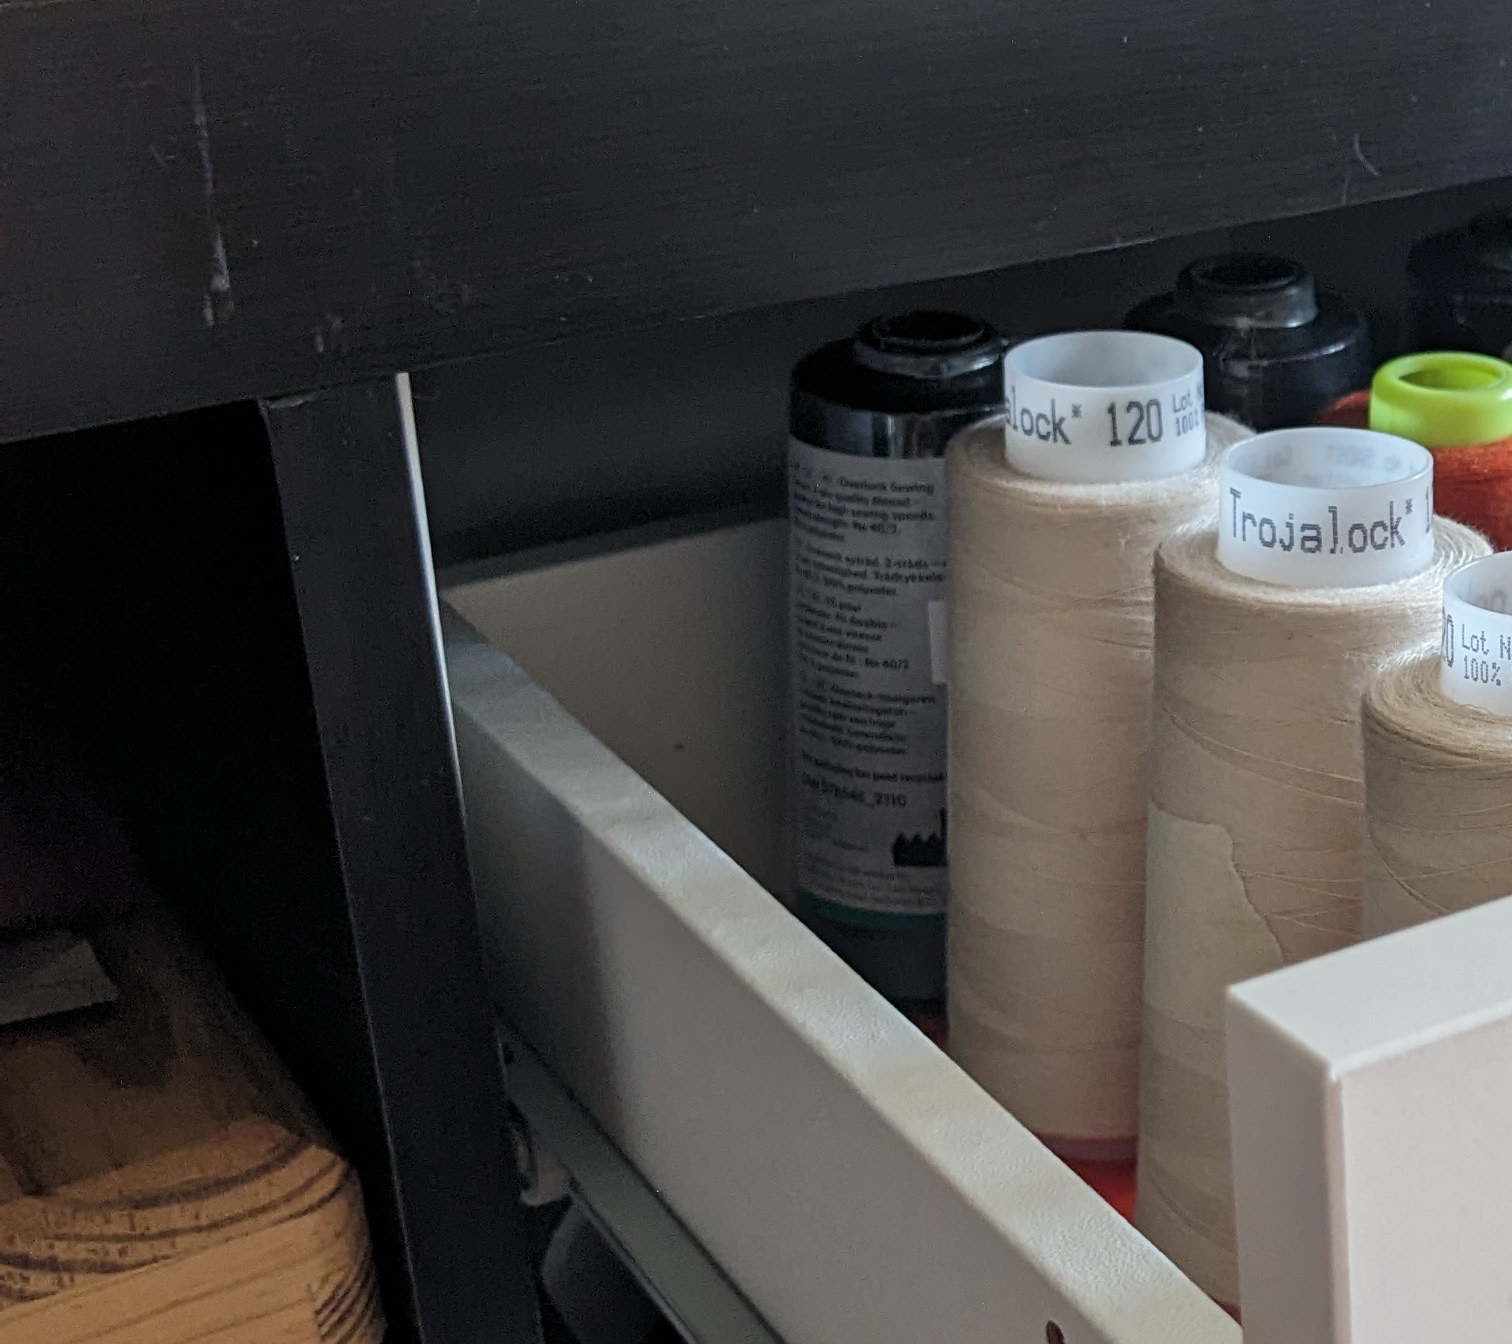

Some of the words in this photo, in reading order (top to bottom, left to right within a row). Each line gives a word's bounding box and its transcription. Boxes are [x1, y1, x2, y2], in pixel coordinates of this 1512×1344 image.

[1171, 388, 1194, 413] Lot
[1107, 398, 1163, 447] 120
[1461, 623, 1490, 656] Lot
[1463, 656, 1502, 687] 100%
